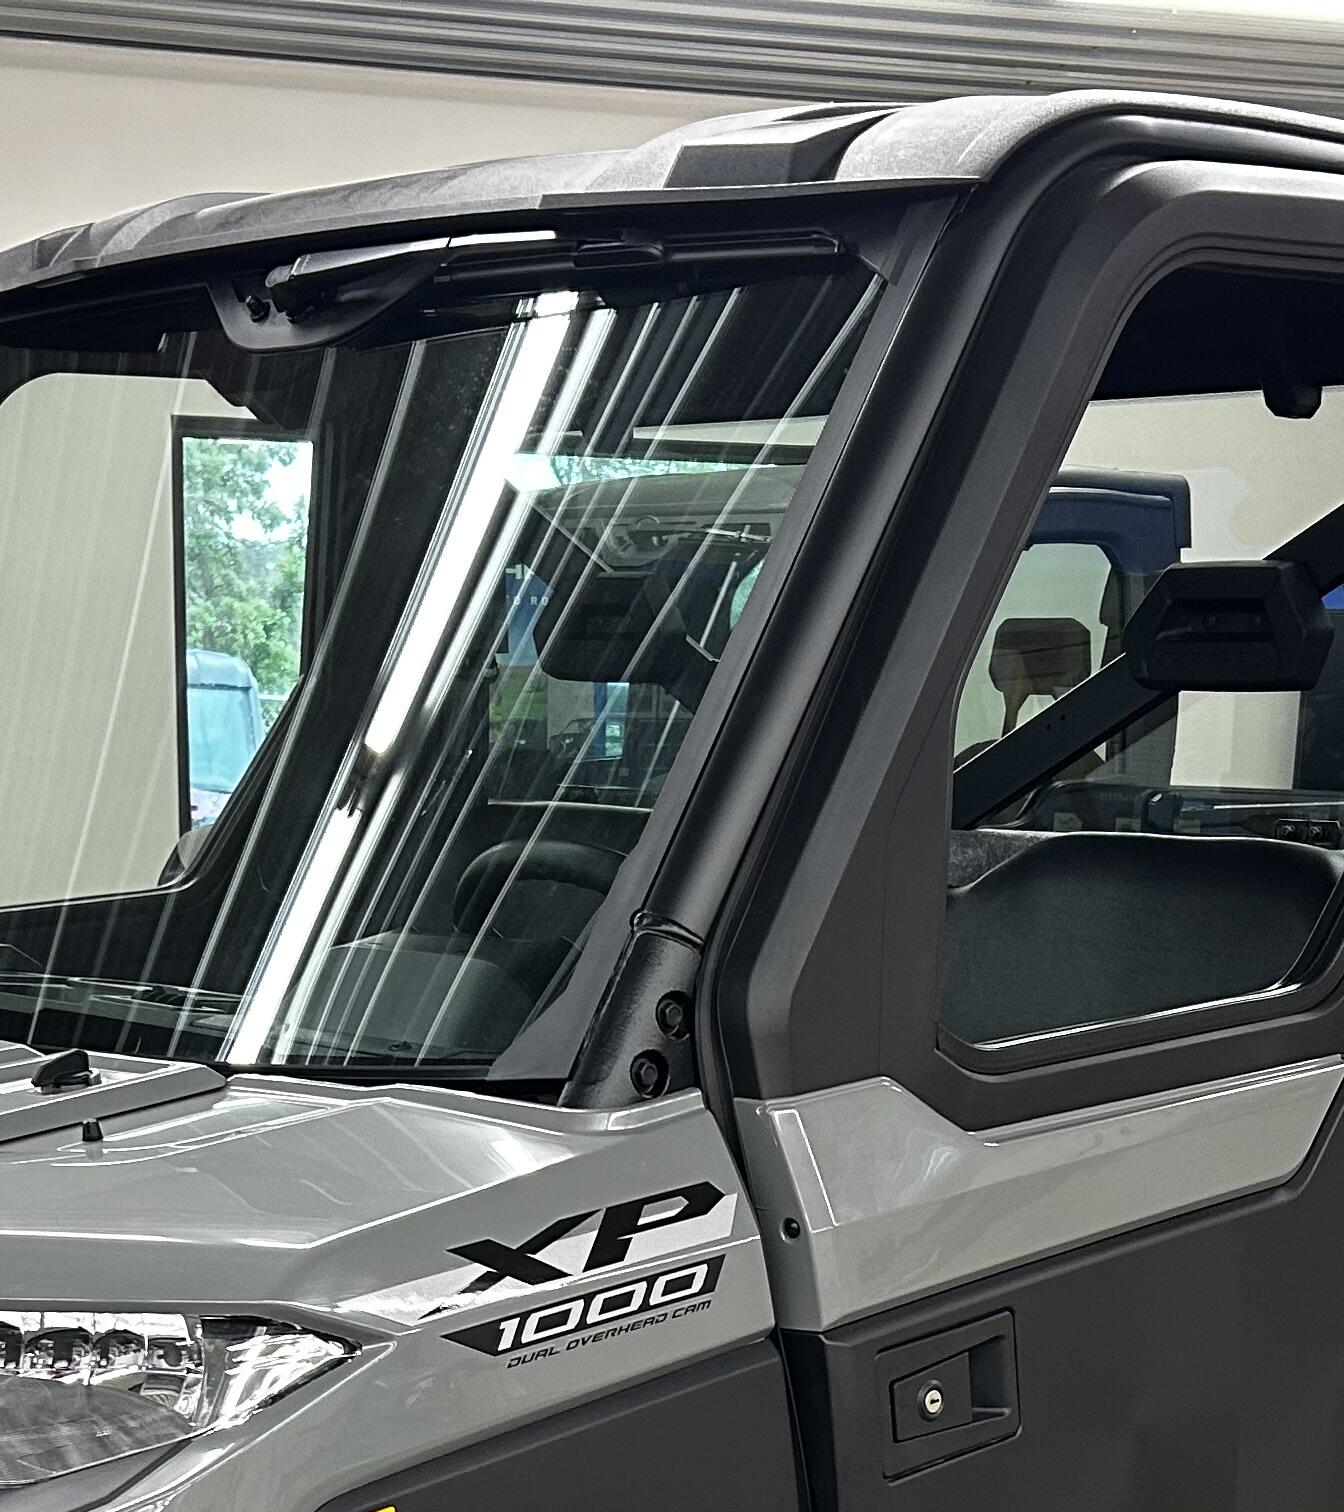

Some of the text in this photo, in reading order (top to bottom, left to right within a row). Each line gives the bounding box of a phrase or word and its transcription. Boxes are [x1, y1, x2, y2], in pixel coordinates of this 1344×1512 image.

[419, 1181, 726, 1320] XP
[497, 1263, 708, 1352] 1000
[507, 1299, 712, 1369] DUAL OVERHEAD CAM
